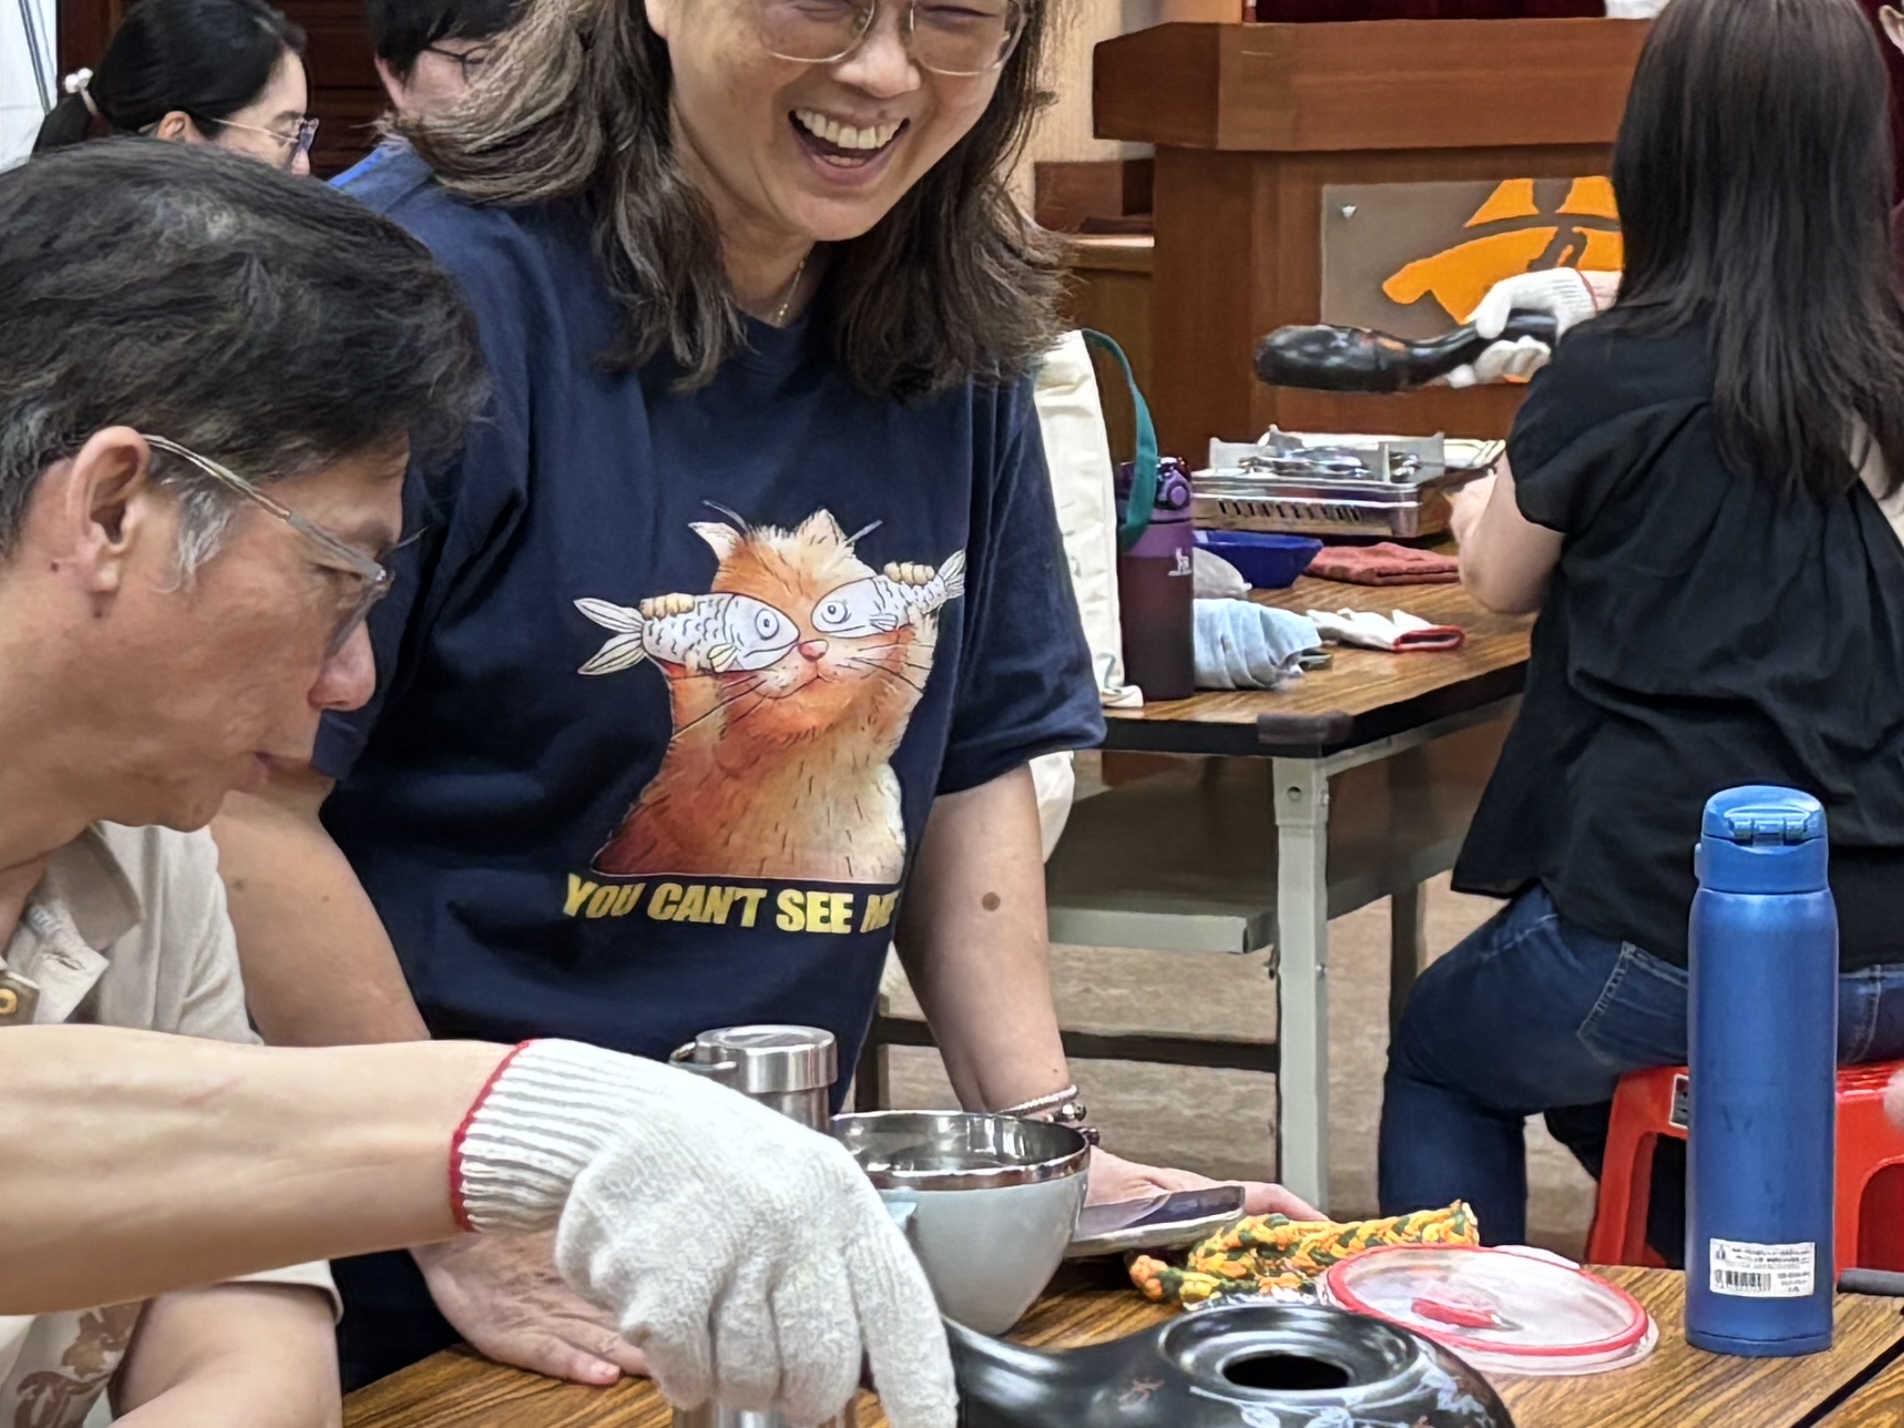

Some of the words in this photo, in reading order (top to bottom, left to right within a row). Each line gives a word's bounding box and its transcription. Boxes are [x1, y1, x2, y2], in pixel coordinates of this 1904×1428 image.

[563, 873, 647, 919] YOU
[647, 882, 768, 927] CAN'T
[776, 888, 854, 934] SEE
